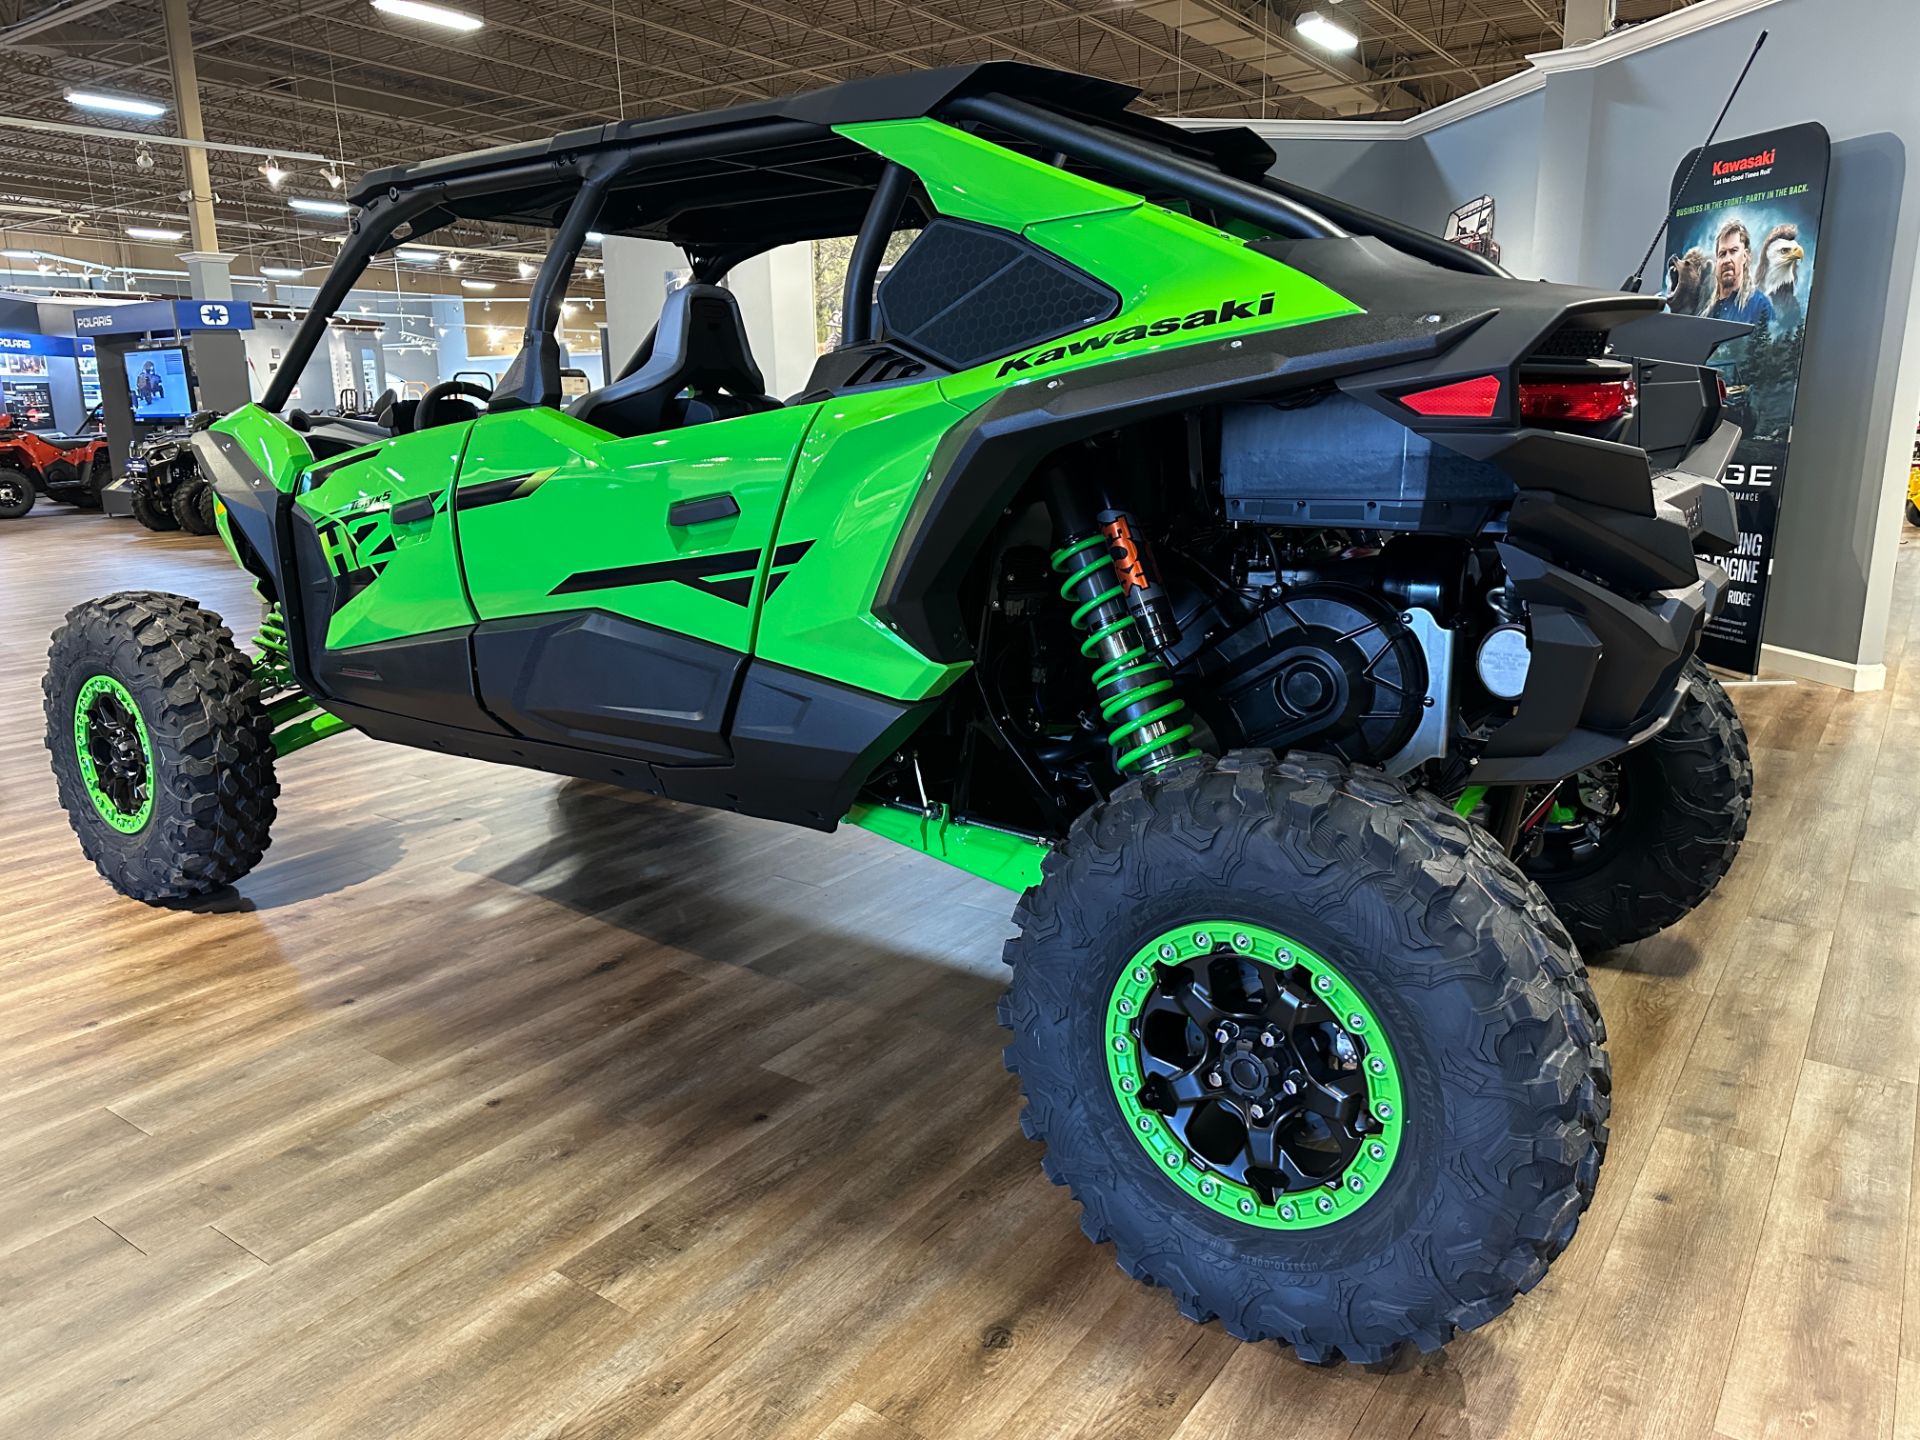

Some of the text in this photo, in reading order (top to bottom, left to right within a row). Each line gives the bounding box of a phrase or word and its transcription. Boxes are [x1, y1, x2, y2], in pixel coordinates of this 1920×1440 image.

[1712, 148, 1776, 176] Kawasaki
[1730, 173, 1745, 182] Good
[1745, 171, 1760, 179] Times
[1675, 204, 1703, 217] BUSINESS
[1704, 202, 1711, 211] IN
[1711, 200, 1723, 209] THE
[1746, 192, 1766, 203] PARTY
[1767, 190, 1774, 199] IN
[1775, 188, 1788, 198] THE
[77, 315, 113, 329] POLARIS
[995, 291, 1276, 379] Kawasaki
[0, 337, 32, 350] POLARIS
[1103, 514, 1149, 598] FOX
[1729, 531, 1763, 557] ING
